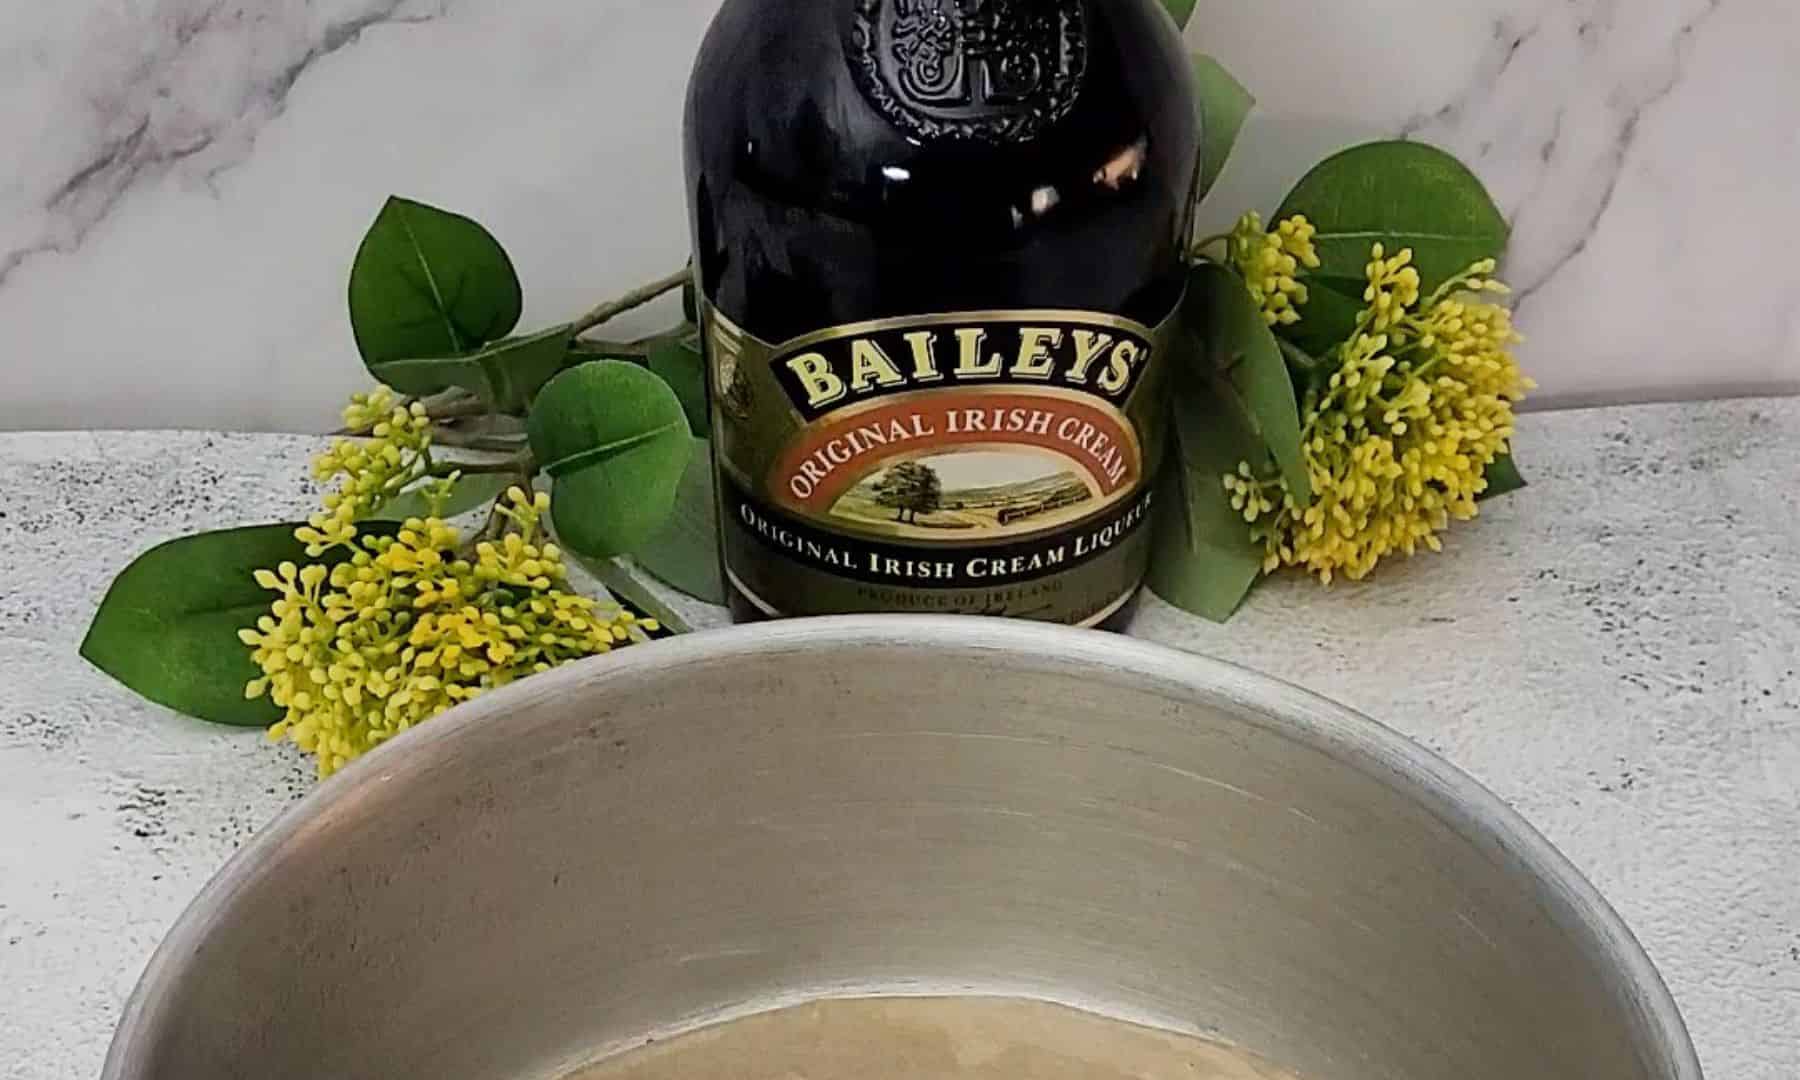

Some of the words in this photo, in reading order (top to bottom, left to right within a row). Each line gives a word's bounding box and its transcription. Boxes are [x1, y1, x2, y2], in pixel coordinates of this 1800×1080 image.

[786, 327, 1139, 407] BAILEYS
[790, 412, 935, 499] ORIGINAL
[945, 408, 1055, 434] IRISH
[1057, 416, 1128, 486] CREAM
[740, 503, 858, 569] ORIGINAL
[869, 552, 954, 579] IRISH
[966, 546, 1065, 578] CREAM
